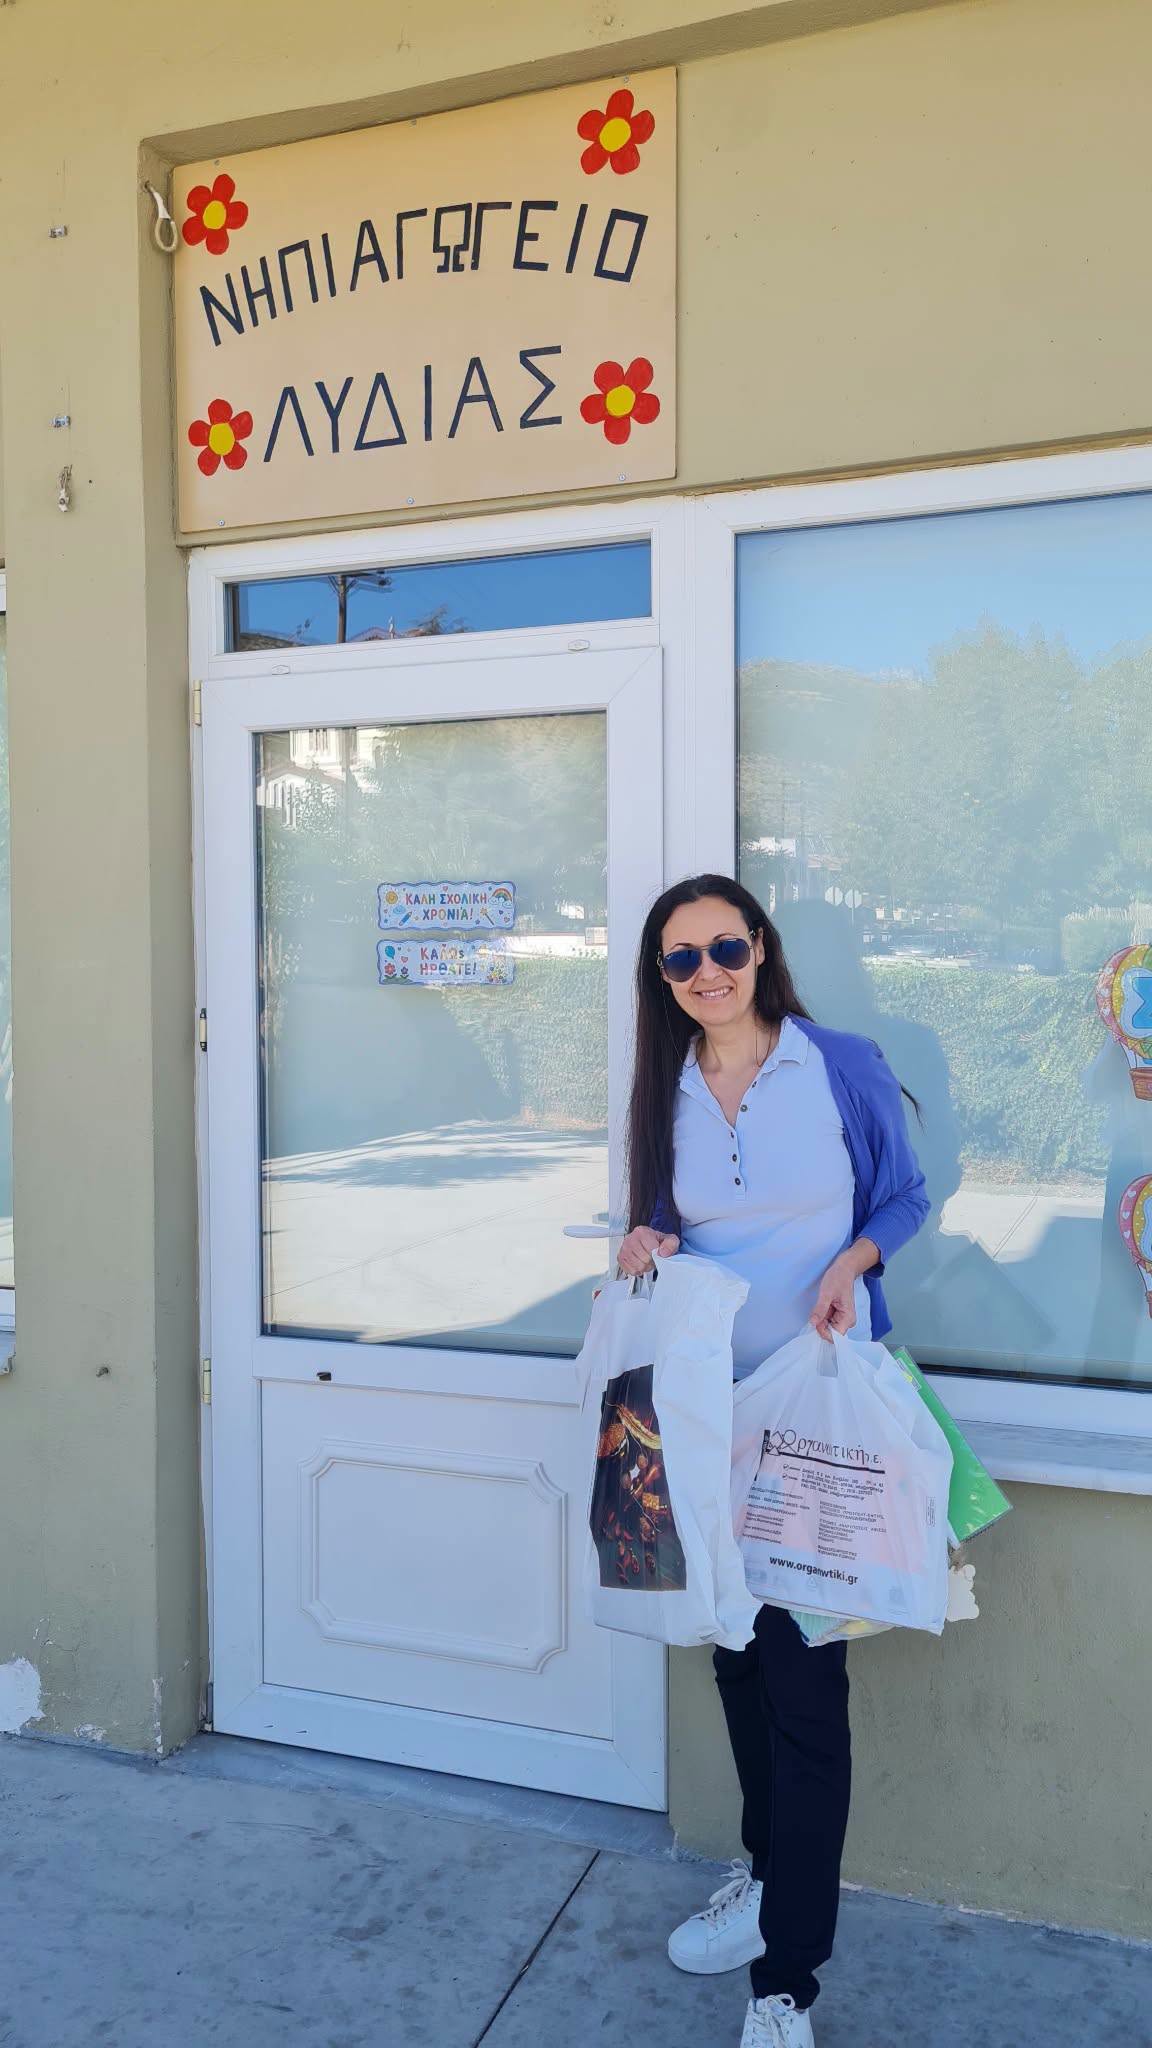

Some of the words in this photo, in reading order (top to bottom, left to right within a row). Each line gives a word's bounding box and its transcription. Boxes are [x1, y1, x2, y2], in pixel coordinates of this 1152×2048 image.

[199, 200, 649, 346] ΝΗΠΙΑΓΩΓΕΙΟ
[263, 345, 563, 463] ΛΥΔΙΑΣ
[405, 892, 436, 905] ΚΑΛΗ
[440, 892, 487, 905] ΣΧΟΛΙΚΗ
